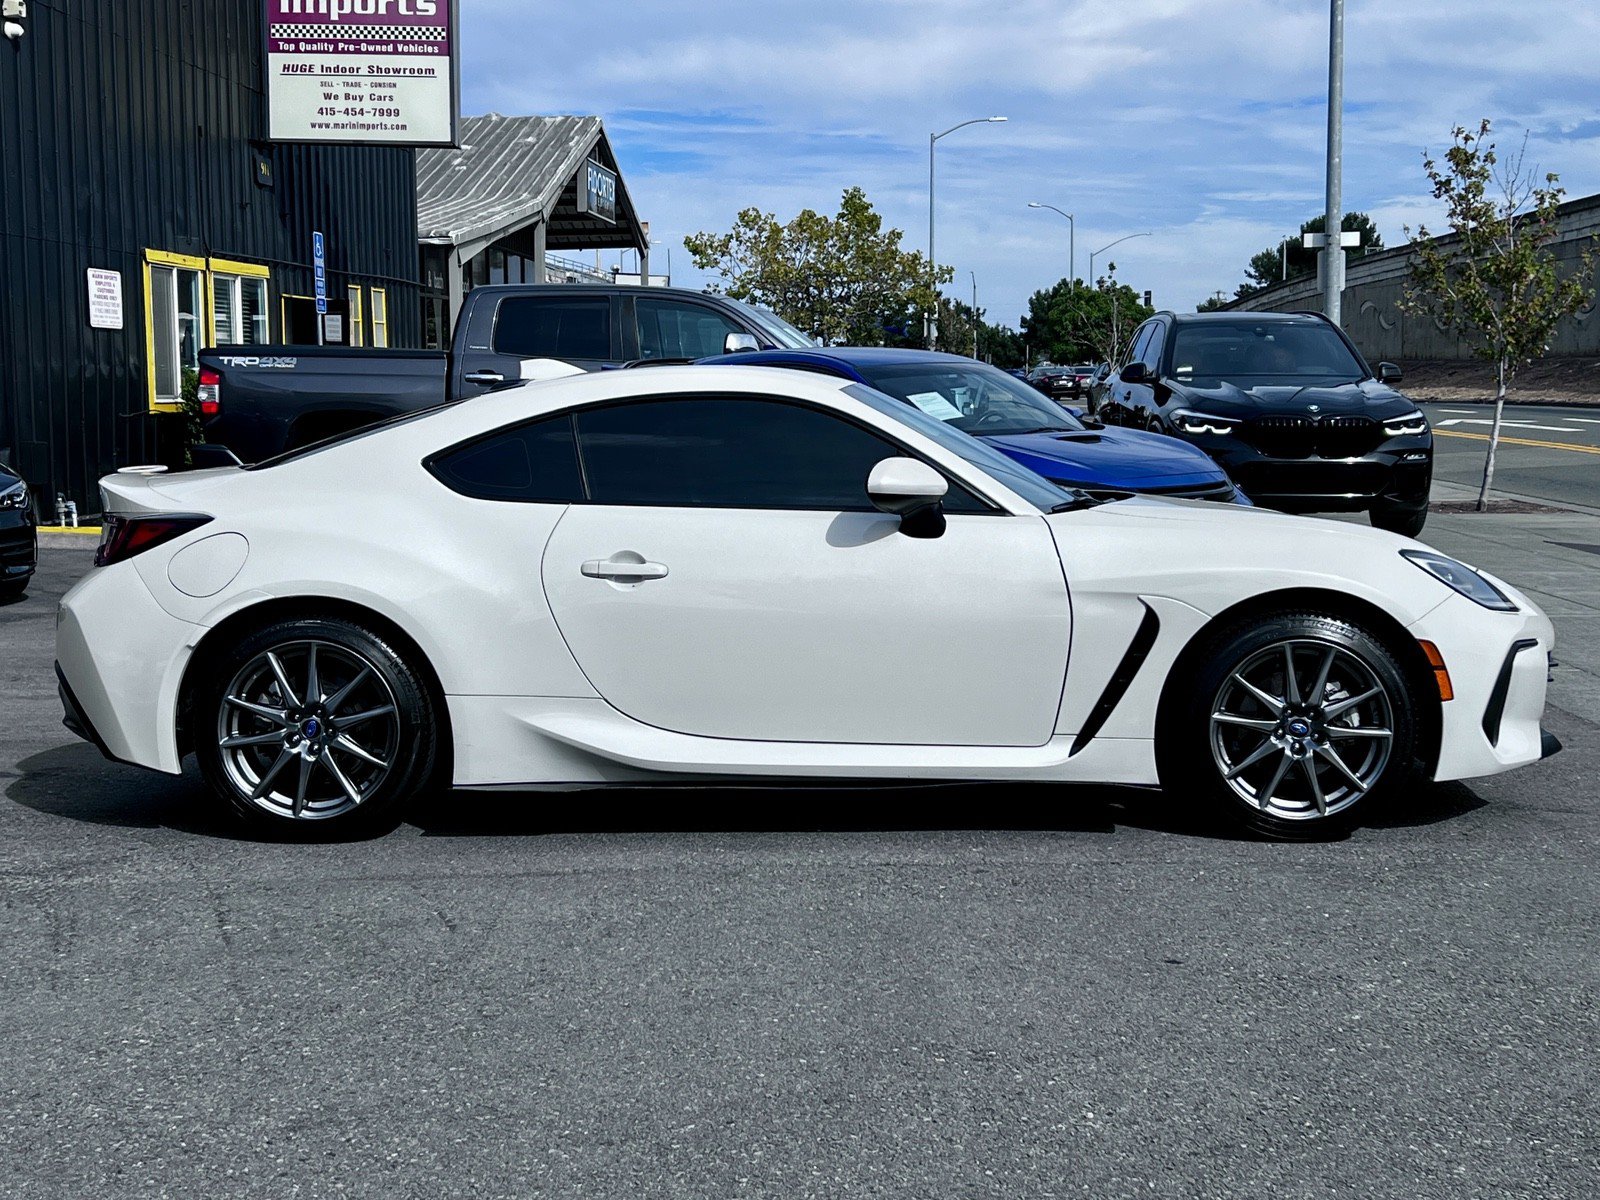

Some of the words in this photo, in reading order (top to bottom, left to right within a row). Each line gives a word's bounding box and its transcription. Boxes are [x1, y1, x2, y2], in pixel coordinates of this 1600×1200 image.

[278, 42, 295, 52] Top
[299, 42, 334, 52] Quality
[338, 43, 393, 52] Pre-Owned
[397, 43, 439, 53] Vehicles
[282, 64, 315, 73] HUGE
[321, 64, 361, 74] Indoor
[367, 65, 435, 75] Showroom
[323, 92, 339, 100] We
[344, 93, 364, 102] Buy
[369, 93, 394, 101] Cars
[317, 107, 400, 117] 415-454-7999
[310, 121, 407, 131] www.marinimports.com
[219, 356, 260, 367] TRD
